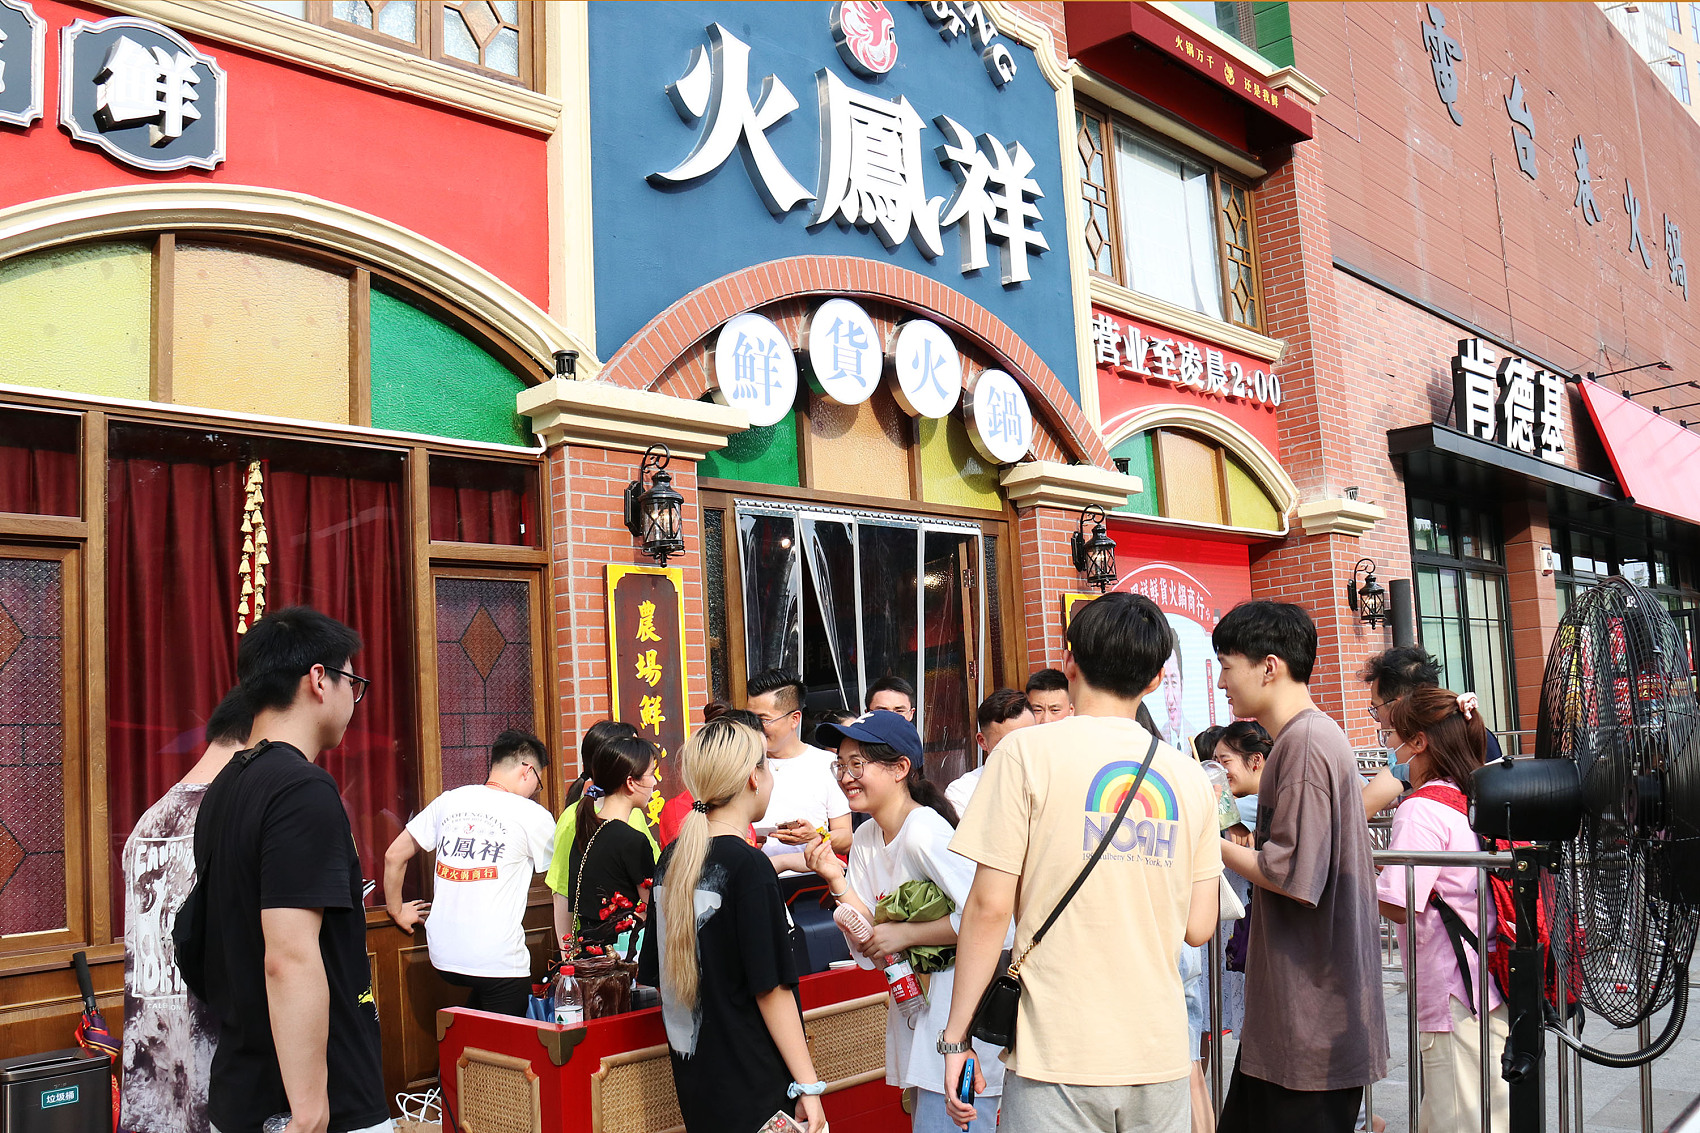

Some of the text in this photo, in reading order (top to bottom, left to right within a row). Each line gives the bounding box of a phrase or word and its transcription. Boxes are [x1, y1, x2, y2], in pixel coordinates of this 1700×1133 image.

[1175, 34, 1215, 69] 火锅万千
[645, 22, 1050, 286] 火鳳祥
[732, 317, 1023, 446] 鮮貨火鍋
[1093, 313, 1281, 407] 营业至凌晨2:00
[1456, 338, 1565, 465] 肯德基
[437, 835, 506, 863] 火鳳祥
[1082, 815, 1179, 859] NOAH
[437, 865, 494, 880] 貨火鍋商行
[46, 1090, 75, 1104] 垃圾桶
